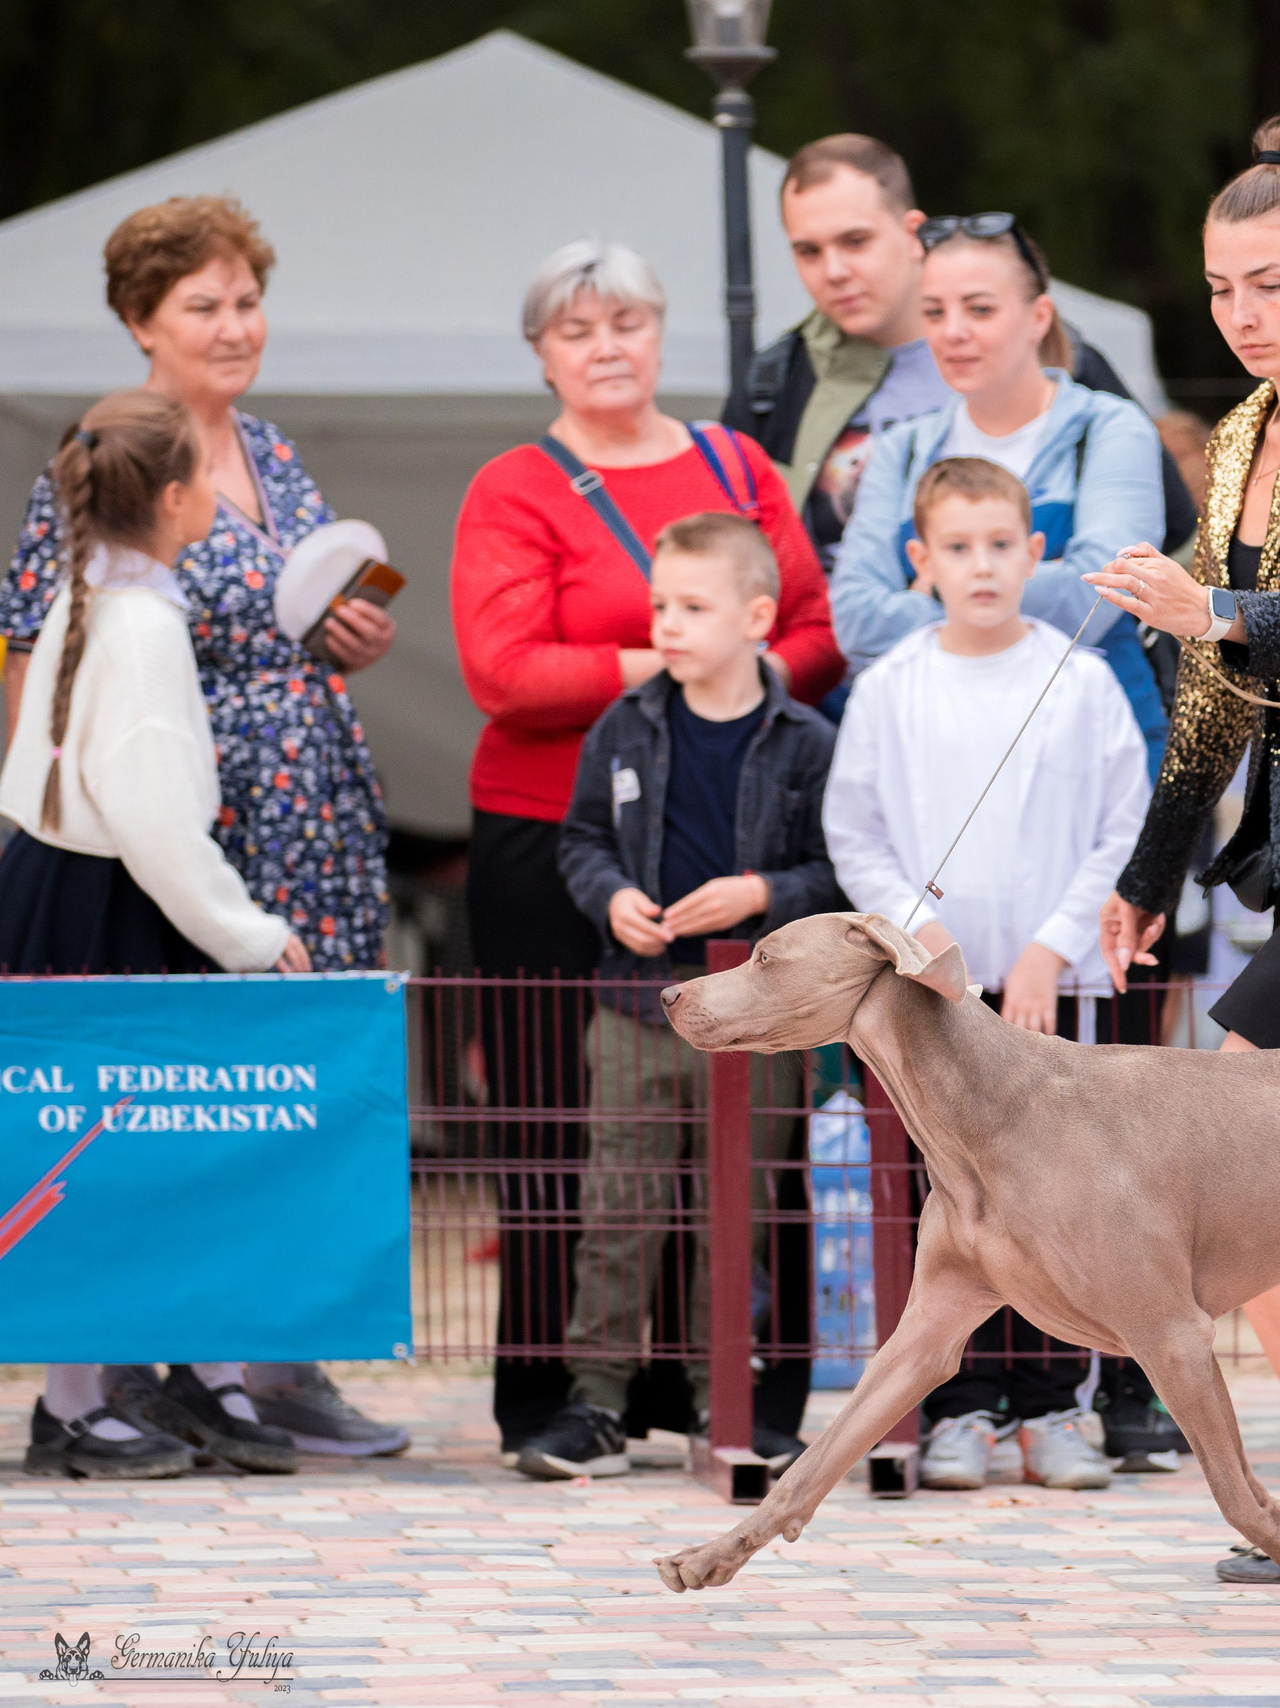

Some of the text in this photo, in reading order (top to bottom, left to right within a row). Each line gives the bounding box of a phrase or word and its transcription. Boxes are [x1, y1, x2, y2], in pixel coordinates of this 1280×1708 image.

[0, 1064, 317, 1093] CAL FEDERATION
[38, 1104, 317, 1132] OF UZBEKISTAN
